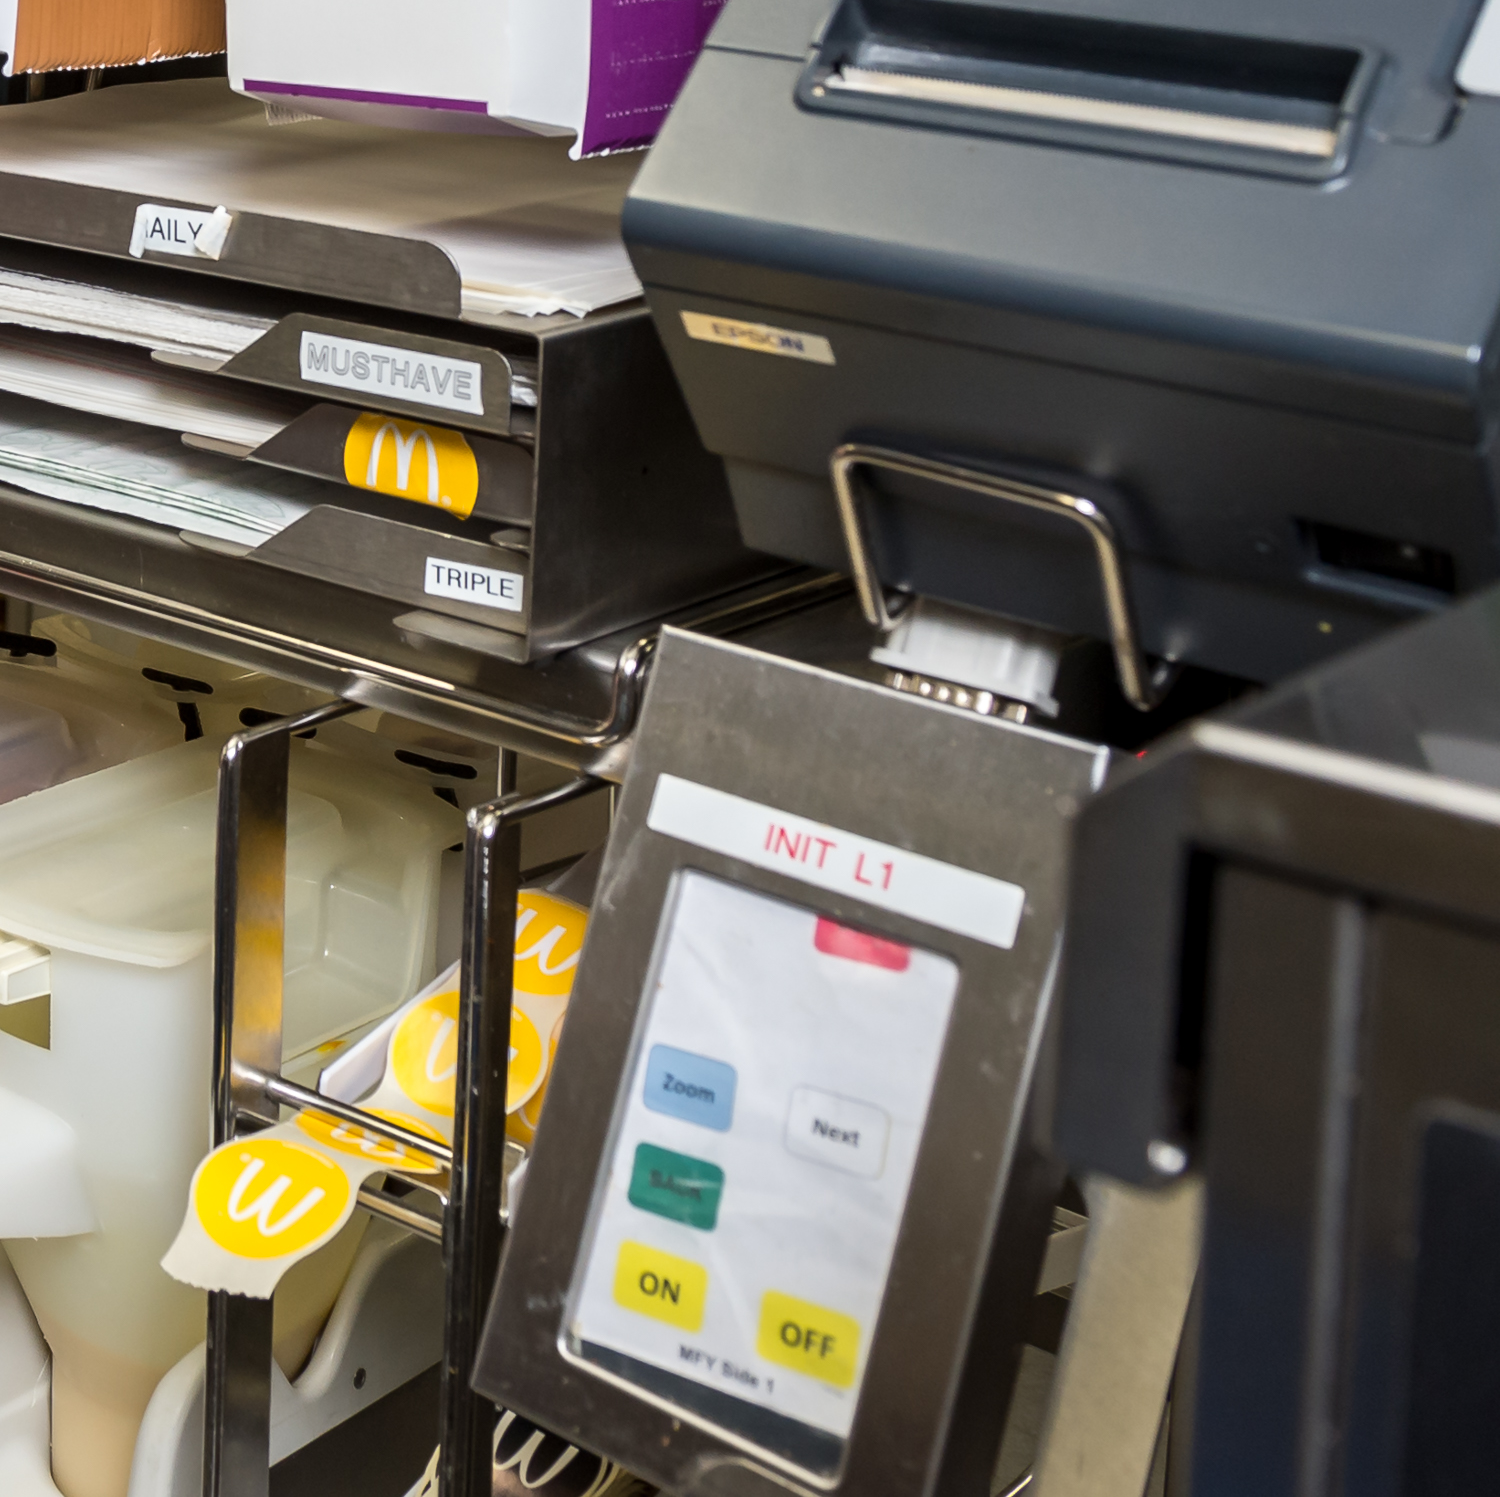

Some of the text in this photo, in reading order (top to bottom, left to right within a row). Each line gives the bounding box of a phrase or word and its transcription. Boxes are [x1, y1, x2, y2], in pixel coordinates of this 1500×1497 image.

[145, 216, 203, 244] AILY
[306, 342, 473, 400] MUSTHAVE
[431, 565, 515, 600] TRIPLE
[763, 823, 895, 890] INIT L1
[662, 1071, 715, 1103] Zoom
[812, 1118, 862, 1149] Next
[639, 1271, 681, 1305] ON
[780, 1320, 836, 1358] OFF
[722, 1360, 760, 1390] Side
[767, 1377, 775, 1393] 1
